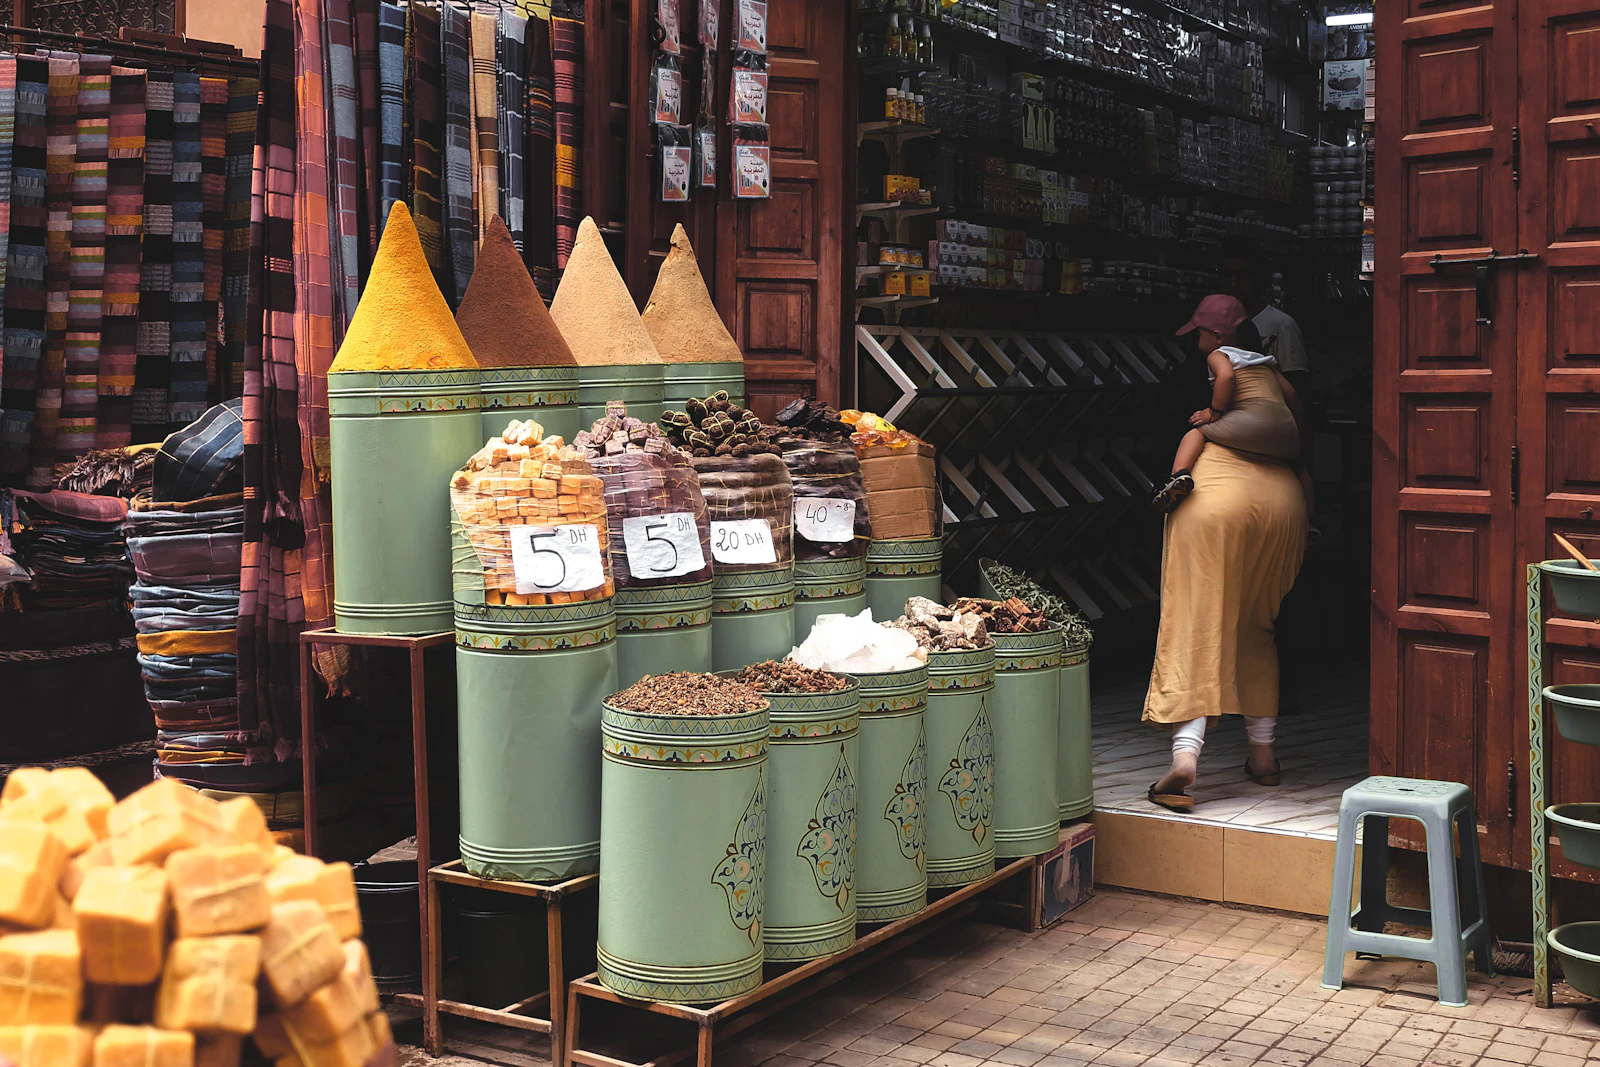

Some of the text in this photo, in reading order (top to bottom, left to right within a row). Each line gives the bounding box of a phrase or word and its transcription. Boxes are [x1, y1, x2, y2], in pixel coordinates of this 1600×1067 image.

[805, 503, 828, 525] 40
[530, 528, 588, 588] 5 DH
[645, 516, 692, 573] 5 DH
[715, 527, 764, 551] 20 DH
